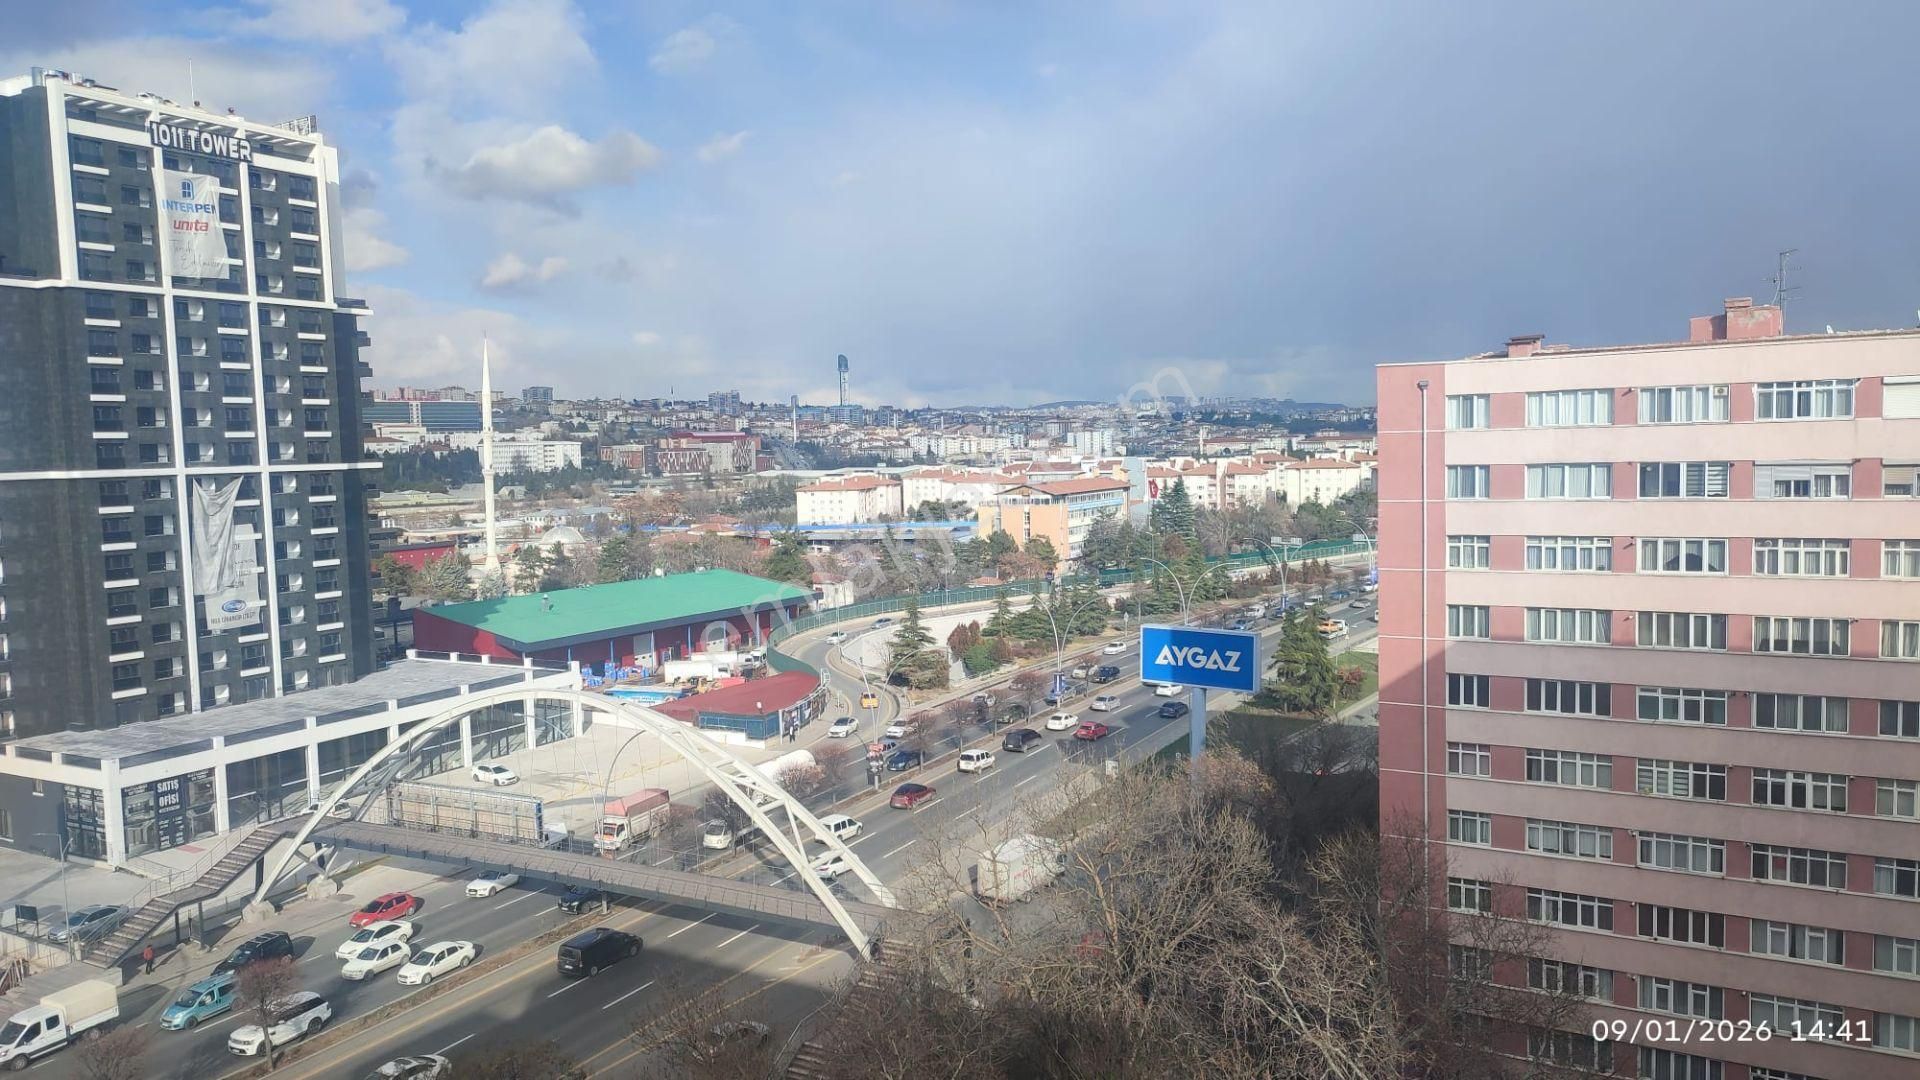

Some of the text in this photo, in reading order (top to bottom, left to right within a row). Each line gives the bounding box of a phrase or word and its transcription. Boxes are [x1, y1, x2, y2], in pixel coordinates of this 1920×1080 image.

[151, 122, 251, 161] 1011 TOWER
[1154, 644, 1242, 672] AYGAZ
